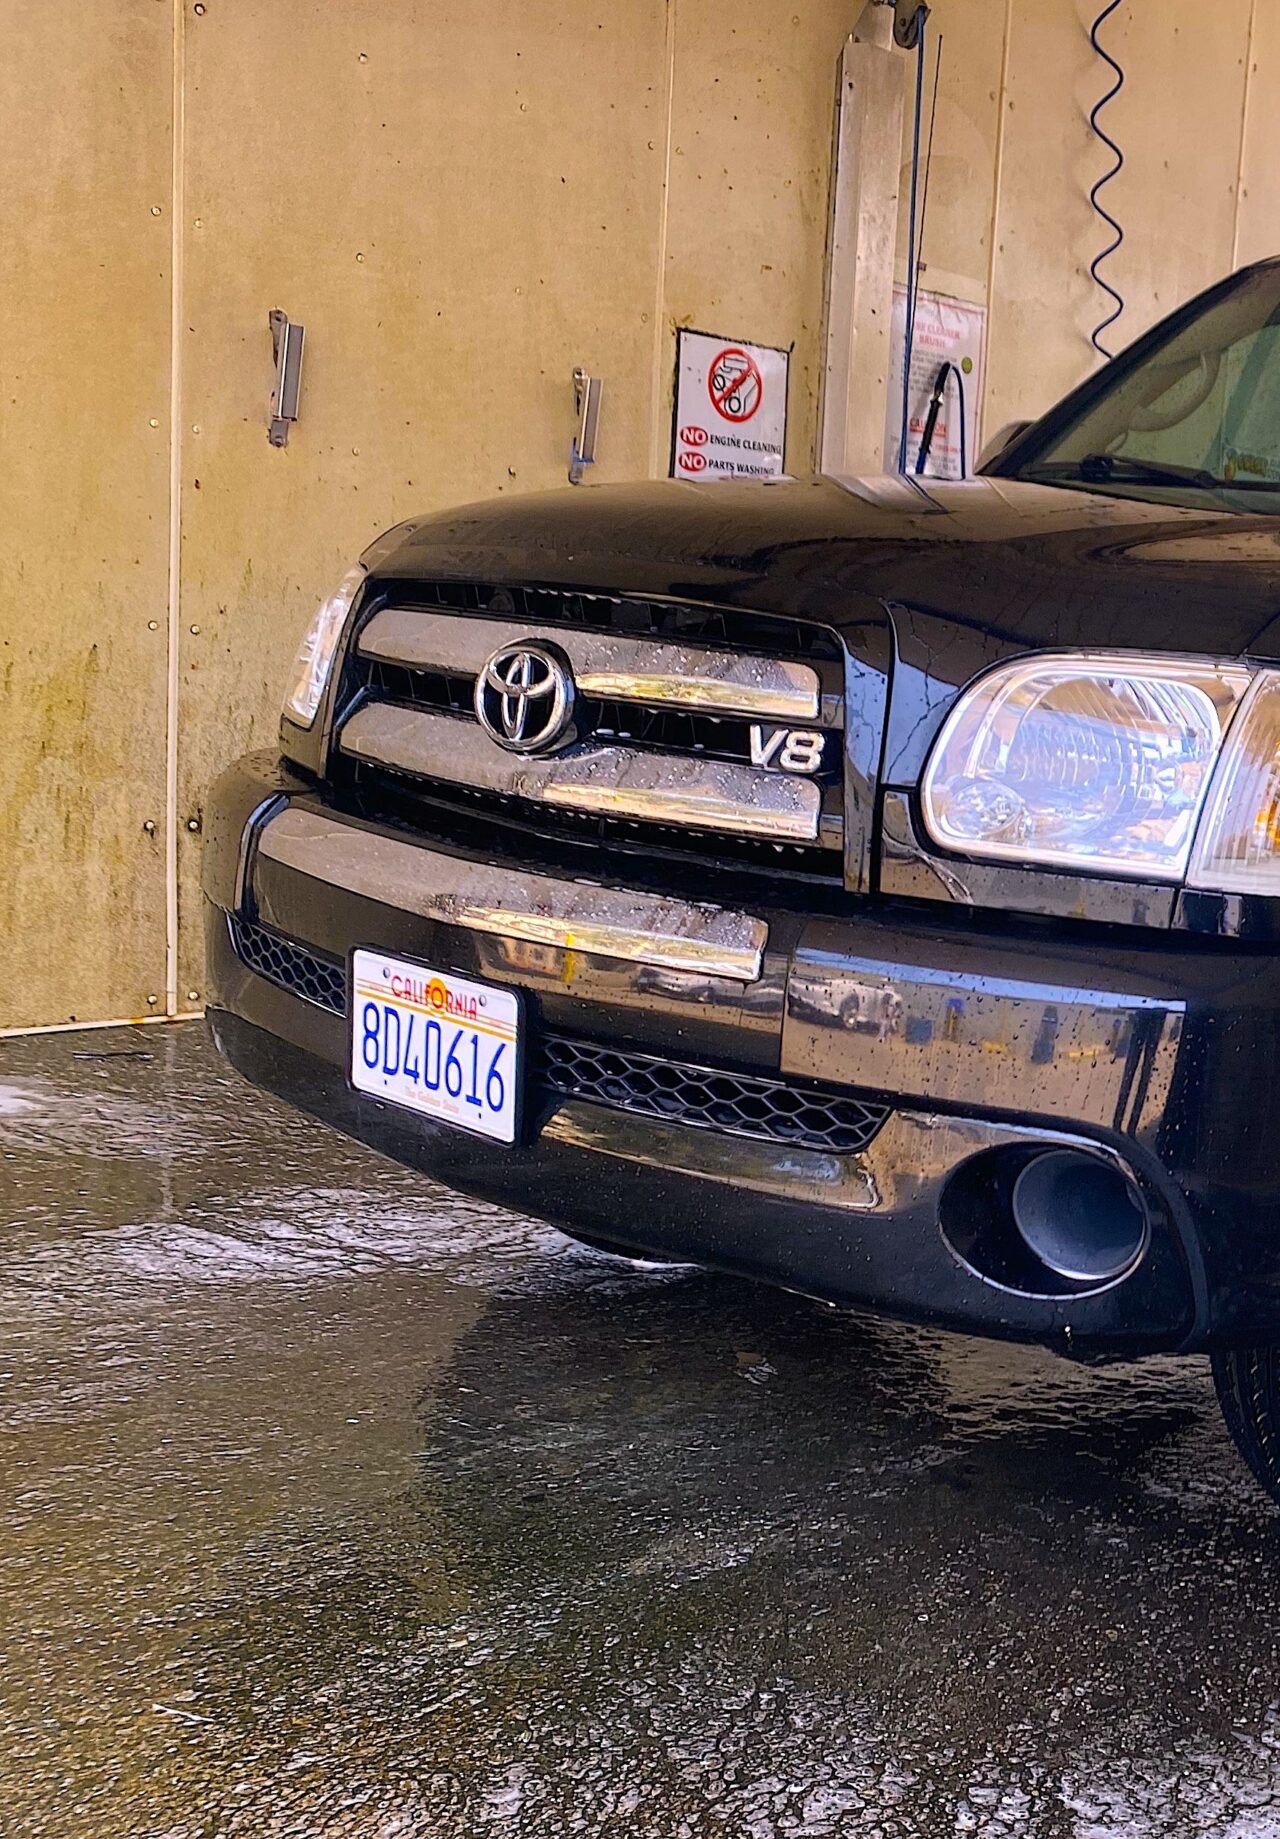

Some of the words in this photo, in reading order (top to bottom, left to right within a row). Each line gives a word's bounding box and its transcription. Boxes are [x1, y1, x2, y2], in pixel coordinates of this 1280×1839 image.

[682, 427, 708, 444] NO
[710, 434, 741, 449] ENGINE
[742, 440, 782, 455] CLEANING
[681, 453, 706, 469] NO
[708, 459, 735, 472] PARTS
[736, 463, 775, 475] WASHING
[750, 725, 825, 773] V8
[391, 975, 477, 1020] CALIFORNIA
[362, 1001, 506, 1112] 8D40616
